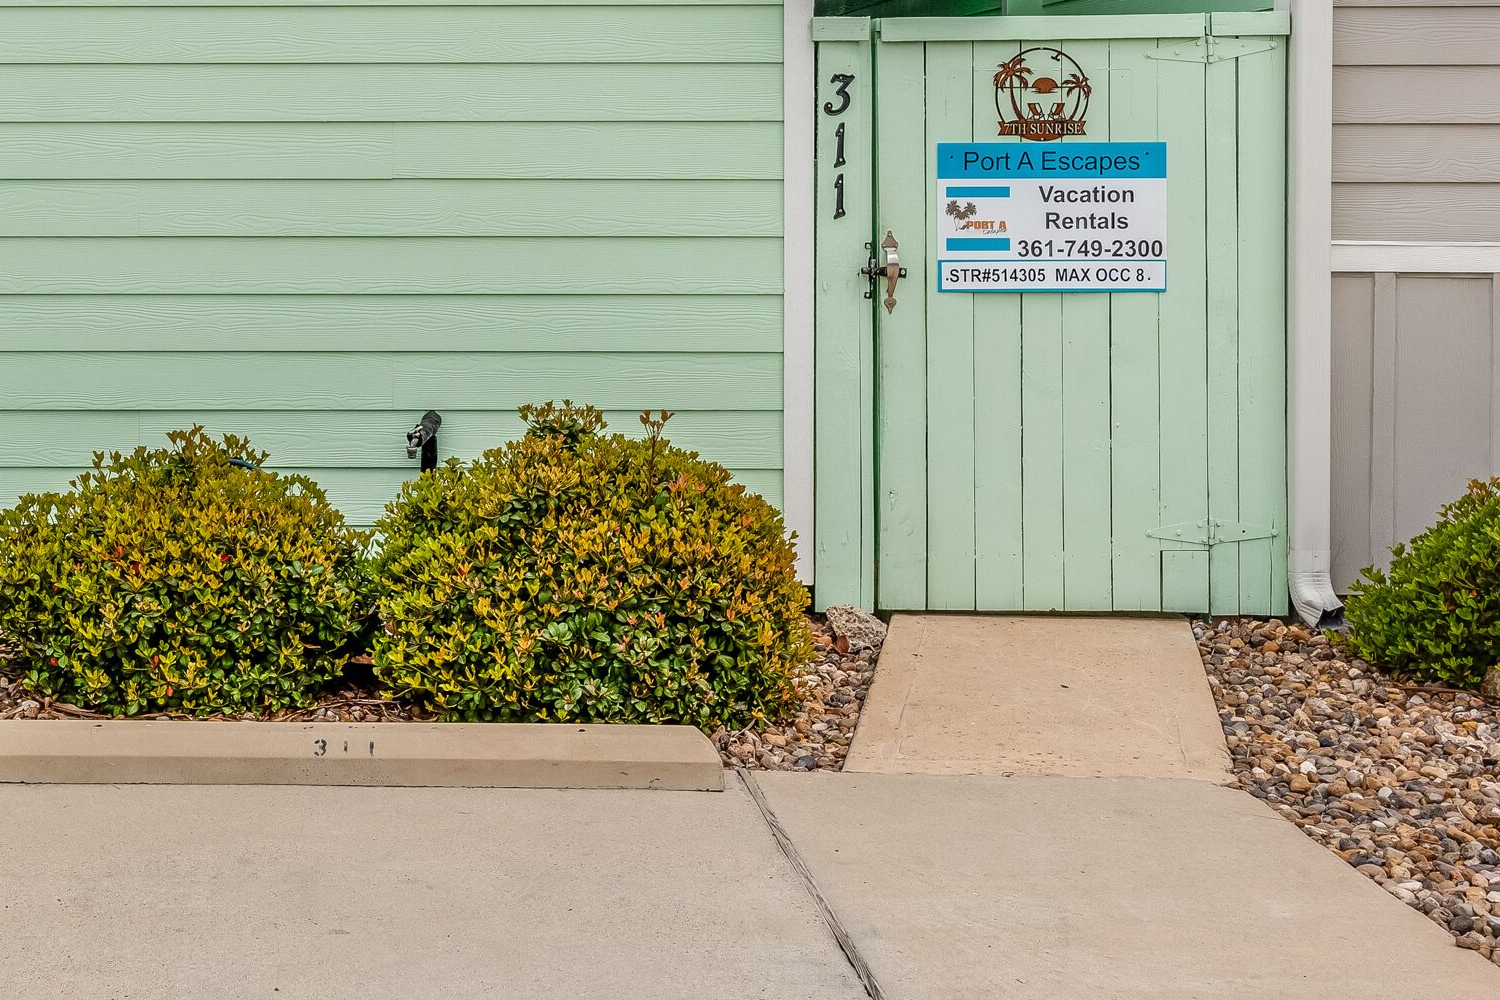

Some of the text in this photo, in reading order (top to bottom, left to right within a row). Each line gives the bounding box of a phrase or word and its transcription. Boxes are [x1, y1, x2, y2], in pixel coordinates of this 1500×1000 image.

[1003, 123, 1082, 135] 7TH SUNRISE
[823, 73, 855, 220] 311
[963, 151, 1140, 175] Port A Escapes
[1038, 185, 1135, 203] Vacation
[966, 220, 1007, 230] PORT A
[1045, 212, 1129, 230] Rentals
[1017, 240, 1163, 258] 361-749-2300
[949, 267, 1145, 282] STR#514305 MAX OCC 8
